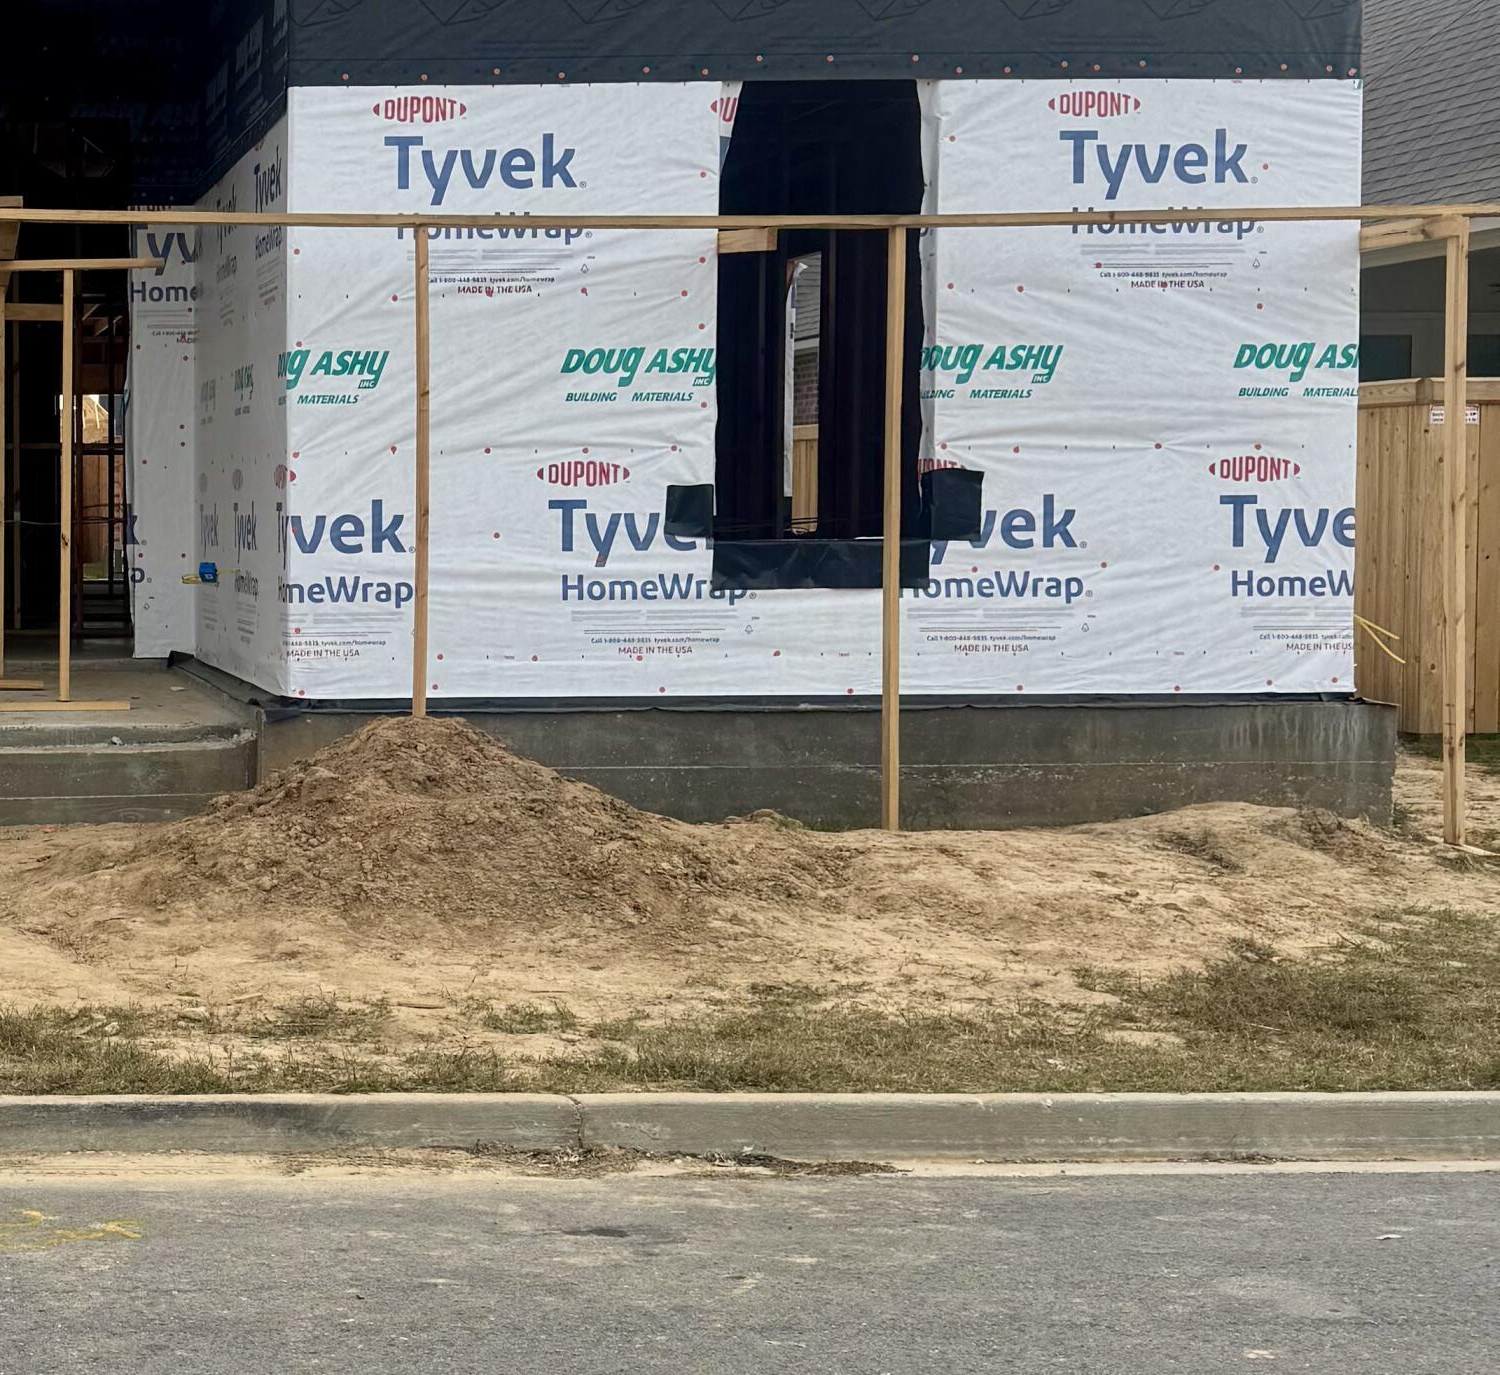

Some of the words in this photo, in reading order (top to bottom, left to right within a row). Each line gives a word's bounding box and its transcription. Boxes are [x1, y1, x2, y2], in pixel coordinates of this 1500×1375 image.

[385, 95, 457, 123] DUPONT
[1060, 90, 1131, 118] DUPONT
[384, 132, 577, 206] Tyvek
[1060, 128, 1248, 201] Tyvek
[457, 285, 483, 294] MADE
[496, 285, 513, 294] THE
[514, 285, 532, 294] USA
[1131, 280, 1156, 289] MADE
[1169, 280, 1186, 289] THE
[1187, 280, 1205, 289] USA
[311, 349, 389, 389] ASHY
[560, 347, 639, 387] DOUG
[984, 344, 1063, 384] ASHY
[1233, 343, 1316, 383] DOUG
[298, 394, 359, 404] MATERIALS
[565, 392, 617, 402] BUILDING
[631, 392, 694, 402] MATERIALS
[970, 389, 1032, 399] MATERIALS
[1238, 387, 1289, 397] BUILDING
[548, 460, 621, 487] DUPONT
[1220, 456, 1292, 482] DUPONT
[928, 493, 1078, 565] vek
[1220, 494, 1355, 564] Tyve
[1231, 570, 1355, 597] HomeW
[286, 649, 311, 657] MADE
[313, 649, 323, 657] IN
[325, 649, 341, 657] THE
[343, 649, 360, 657] USA
[618, 646, 644, 655] MADE
[646, 646, 655, 655] IN
[657, 646, 674, 654] THE
[675, 646, 693, 654] USA
[954, 644, 980, 653] MADE
[981, 644, 991, 652] IN
[993, 644, 1010, 652] THE
[1011, 644, 1029, 652] USA
[1286, 643, 1311, 651] MADE
[1313, 643, 1322, 651] IN
[1324, 643, 1340, 651] THE
[1341, 643, 1353, 651] US
